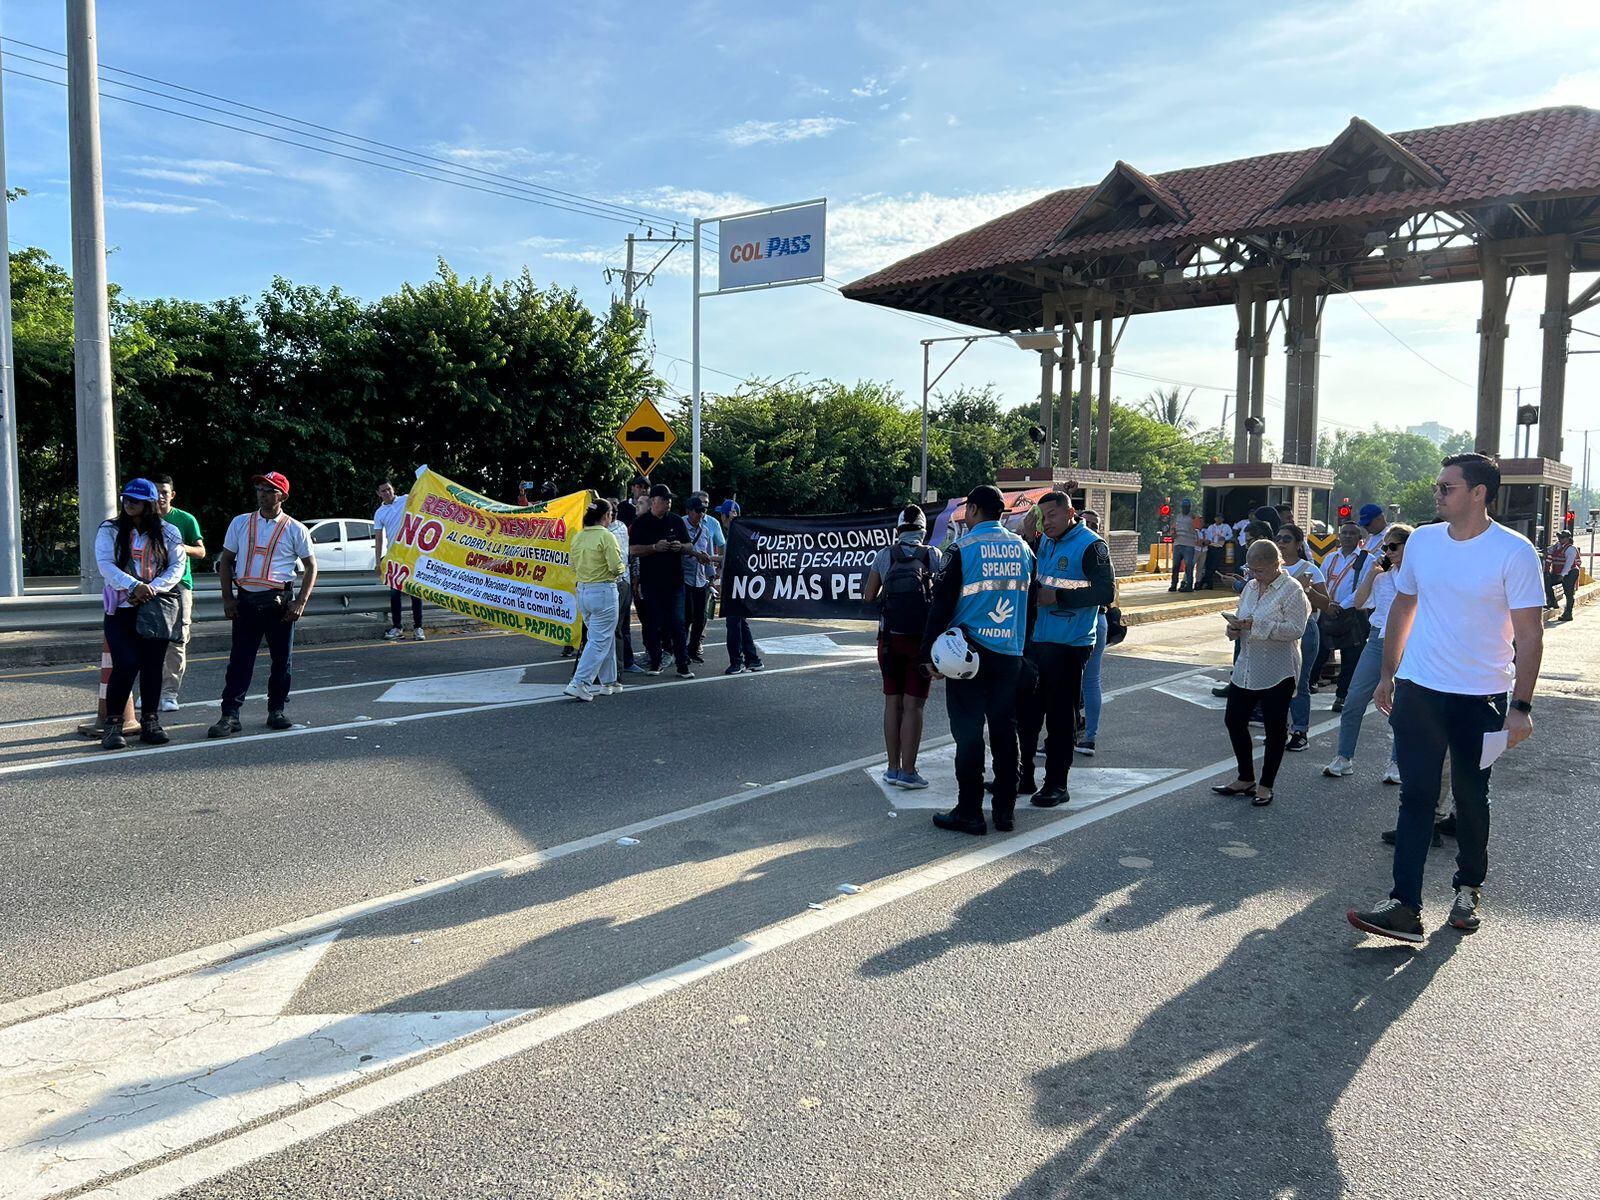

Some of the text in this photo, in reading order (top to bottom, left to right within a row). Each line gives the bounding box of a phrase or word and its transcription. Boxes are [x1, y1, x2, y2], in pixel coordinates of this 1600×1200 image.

[420, 493, 486, 531] RESISTE
[395, 511, 445, 553] NO
[446, 531, 457, 542] AL
[459, 534, 486, 551] COBRO
[486, 541, 492, 552] A
[492, 543, 501, 554] LA
[817, 528, 899, 549] COLOMBIA
[747, 553, 798, 572] QUIERE
[980, 542, 1021, 559] DIÁLOGO
[425, 560, 564, 605] Exigimos al Gobierno Nacional cumplir con los
[515, 561, 529, 578] C1
[532, 564, 547, 582] C2
[732, 568, 865, 600] NO MÁS PE
[982, 562, 1022, 577] SPEAKER
[383, 559, 410, 592] NO
[422, 589, 458, 611] CASETA
[457, 599, 472, 615] DE
[472, 604, 523, 629] CONTROL
[524, 616, 572, 643] PAPIROS
[415, 570, 443, 585] acuerdos
[441, 578, 464, 593] logrados
[464, 587, 474, 595] en
[481, 591, 502, 604] mesas
[502, 595, 516, 607] con
[517, 597, 526, 610] la
[526, 601, 573, 620] comunidad.
